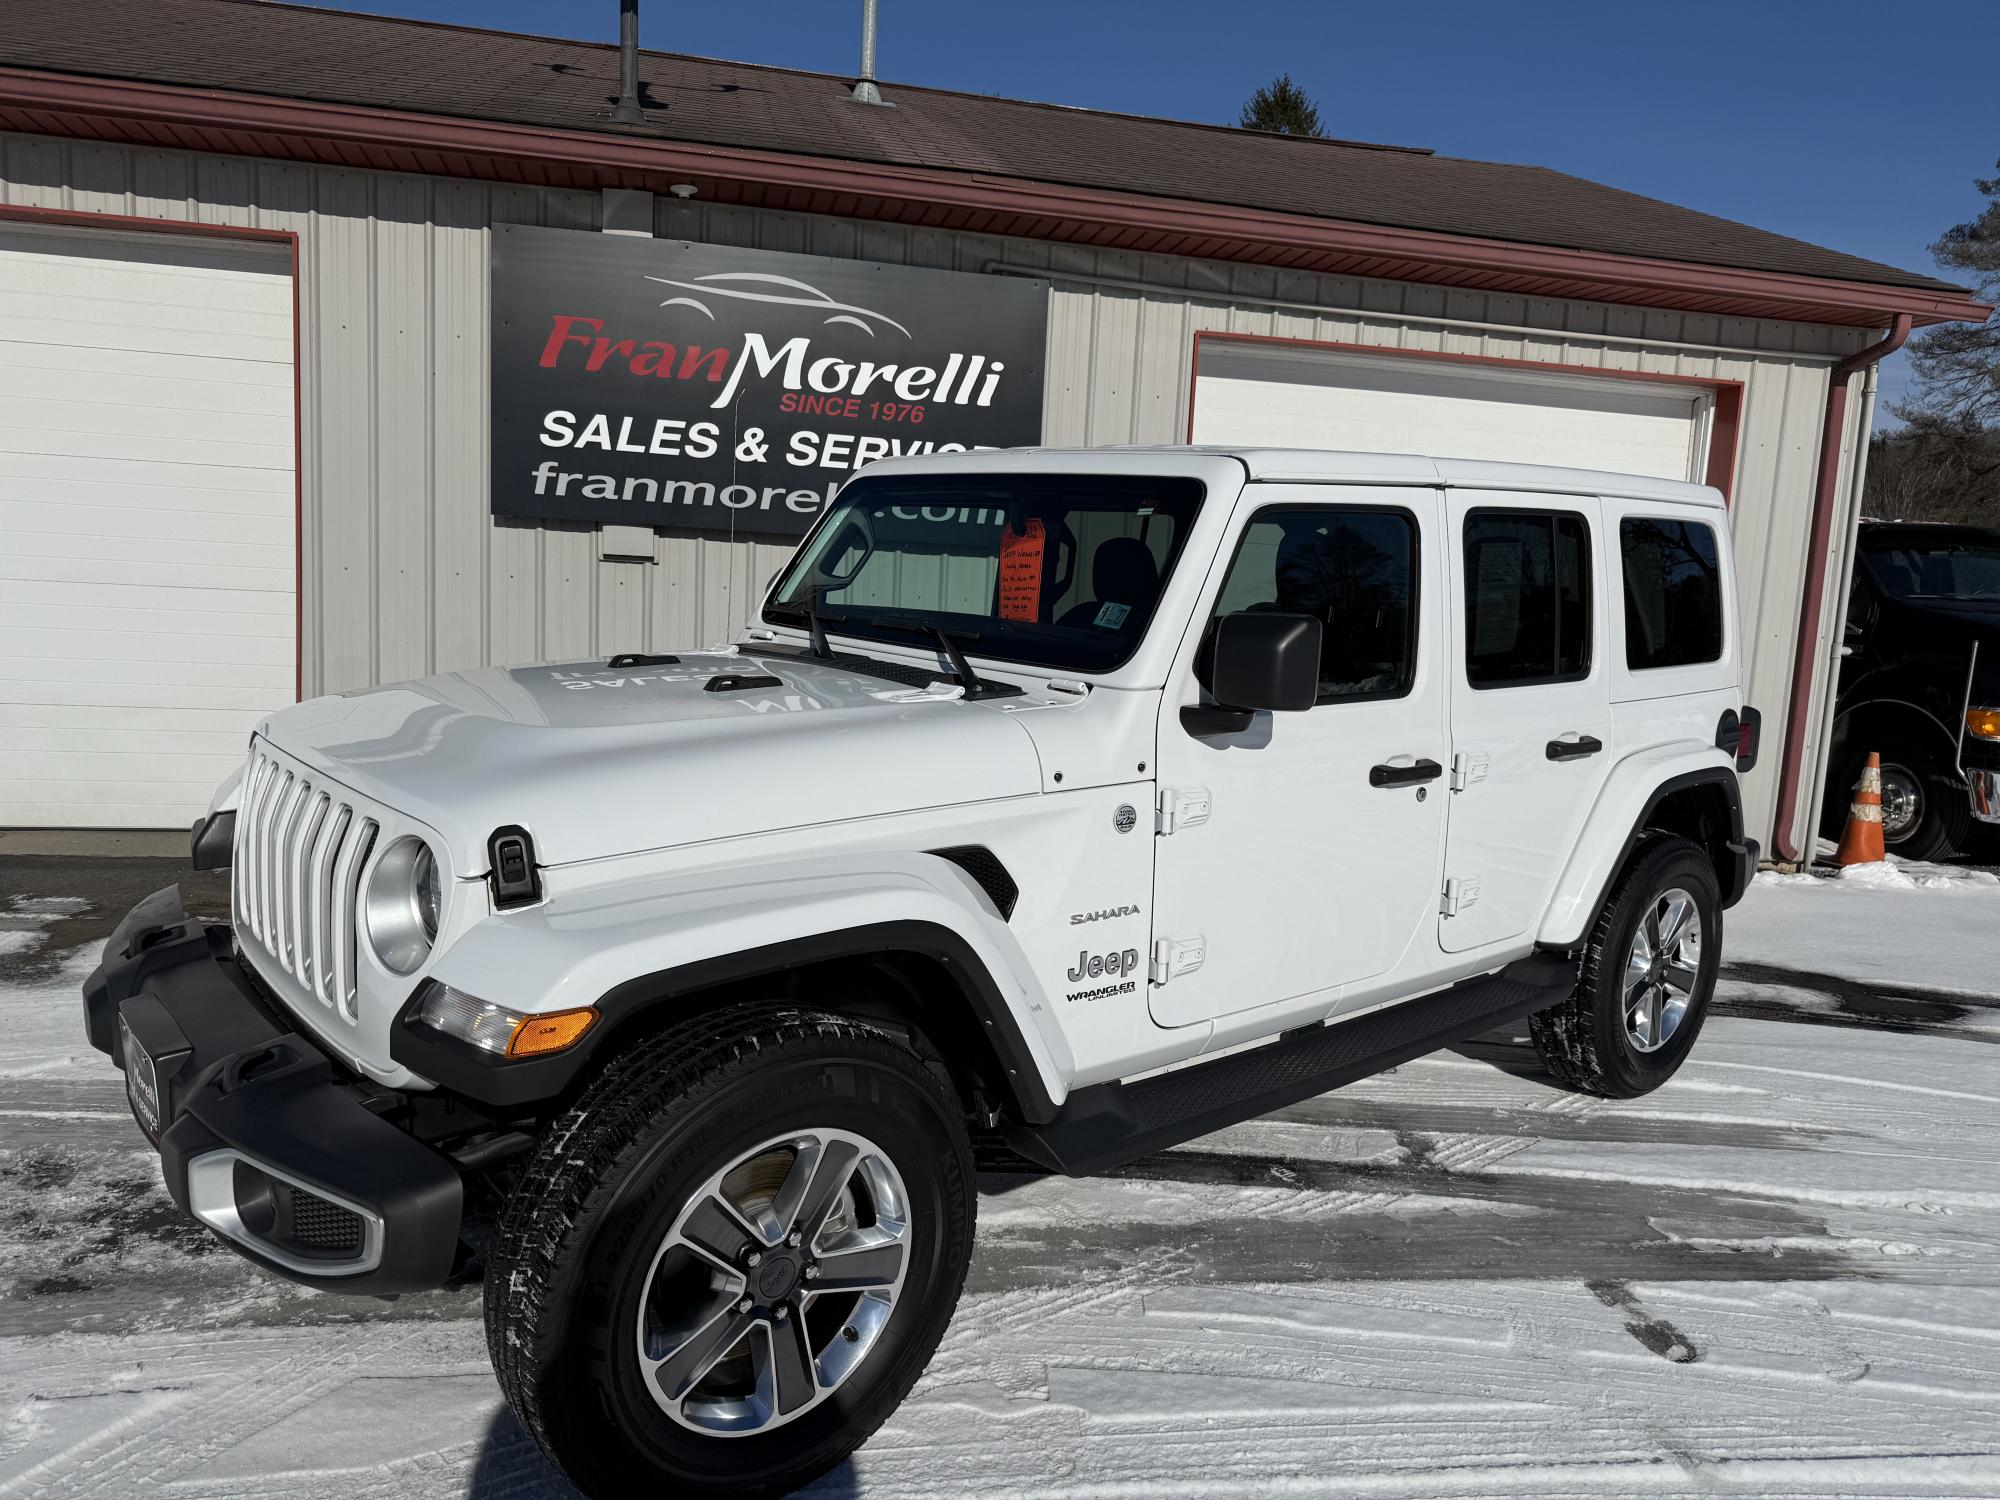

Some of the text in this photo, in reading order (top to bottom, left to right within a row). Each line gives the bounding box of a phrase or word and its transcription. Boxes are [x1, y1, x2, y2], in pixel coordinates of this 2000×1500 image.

[780, 393, 925, 424] SINCE 1976
[539, 410, 719, 459] SALES
[736, 427, 769, 463] &
[1070, 904, 1140, 926] SAHARA
[1067, 948, 1139, 982] Jeep
[1066, 981, 1136, 1002] WRANGLER
[1088, 987, 1136, 1002] UNLIMITED
